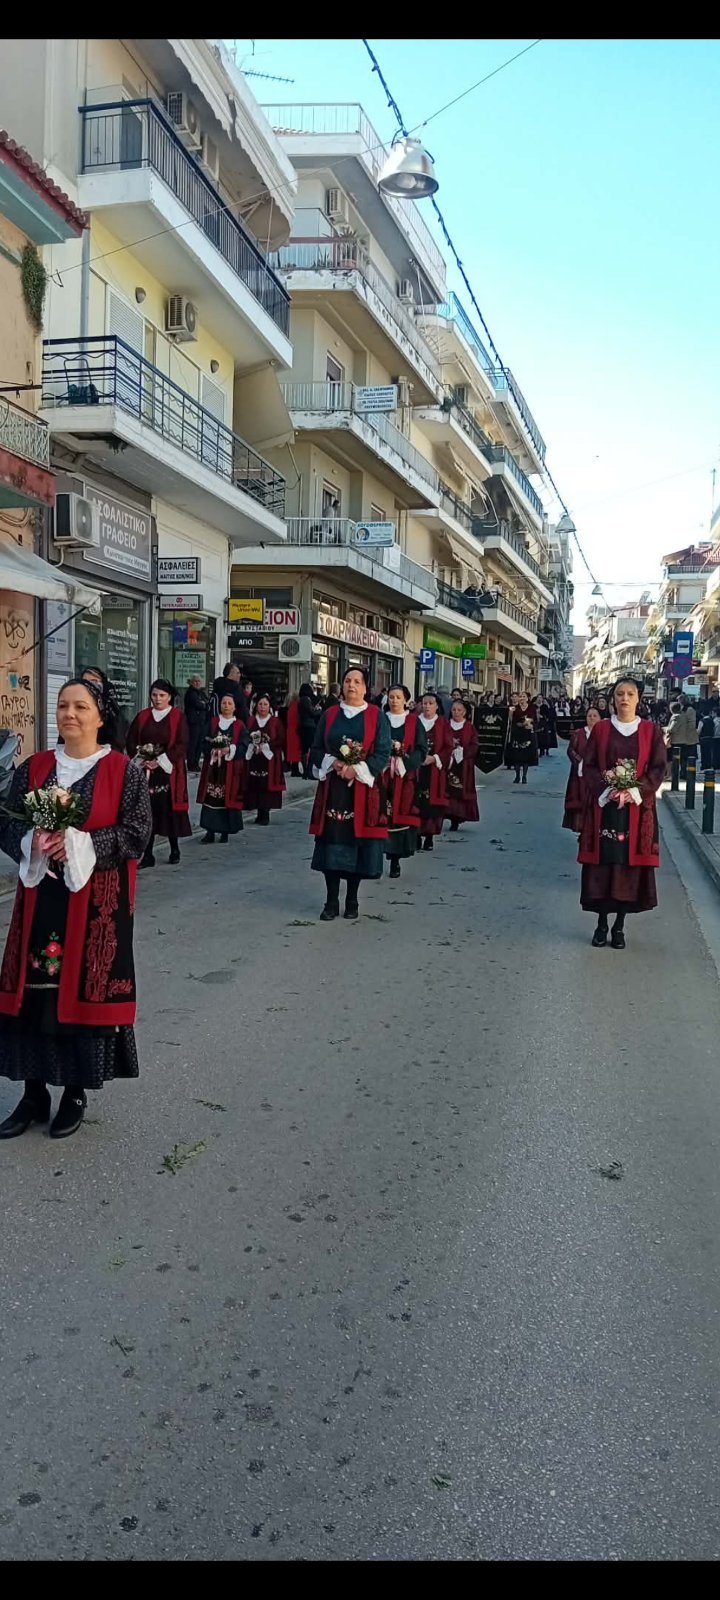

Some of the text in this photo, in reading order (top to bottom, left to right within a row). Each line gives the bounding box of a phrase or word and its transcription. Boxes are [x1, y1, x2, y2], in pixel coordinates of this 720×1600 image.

[102, 523, 137, 550] ΓΡΑΦΕΙΟ
[159, 561, 196, 571] ΑΣΦΑΛΕΙΕΣ
[422, 650, 432, 664] P
[464, 659, 472, 670] P
